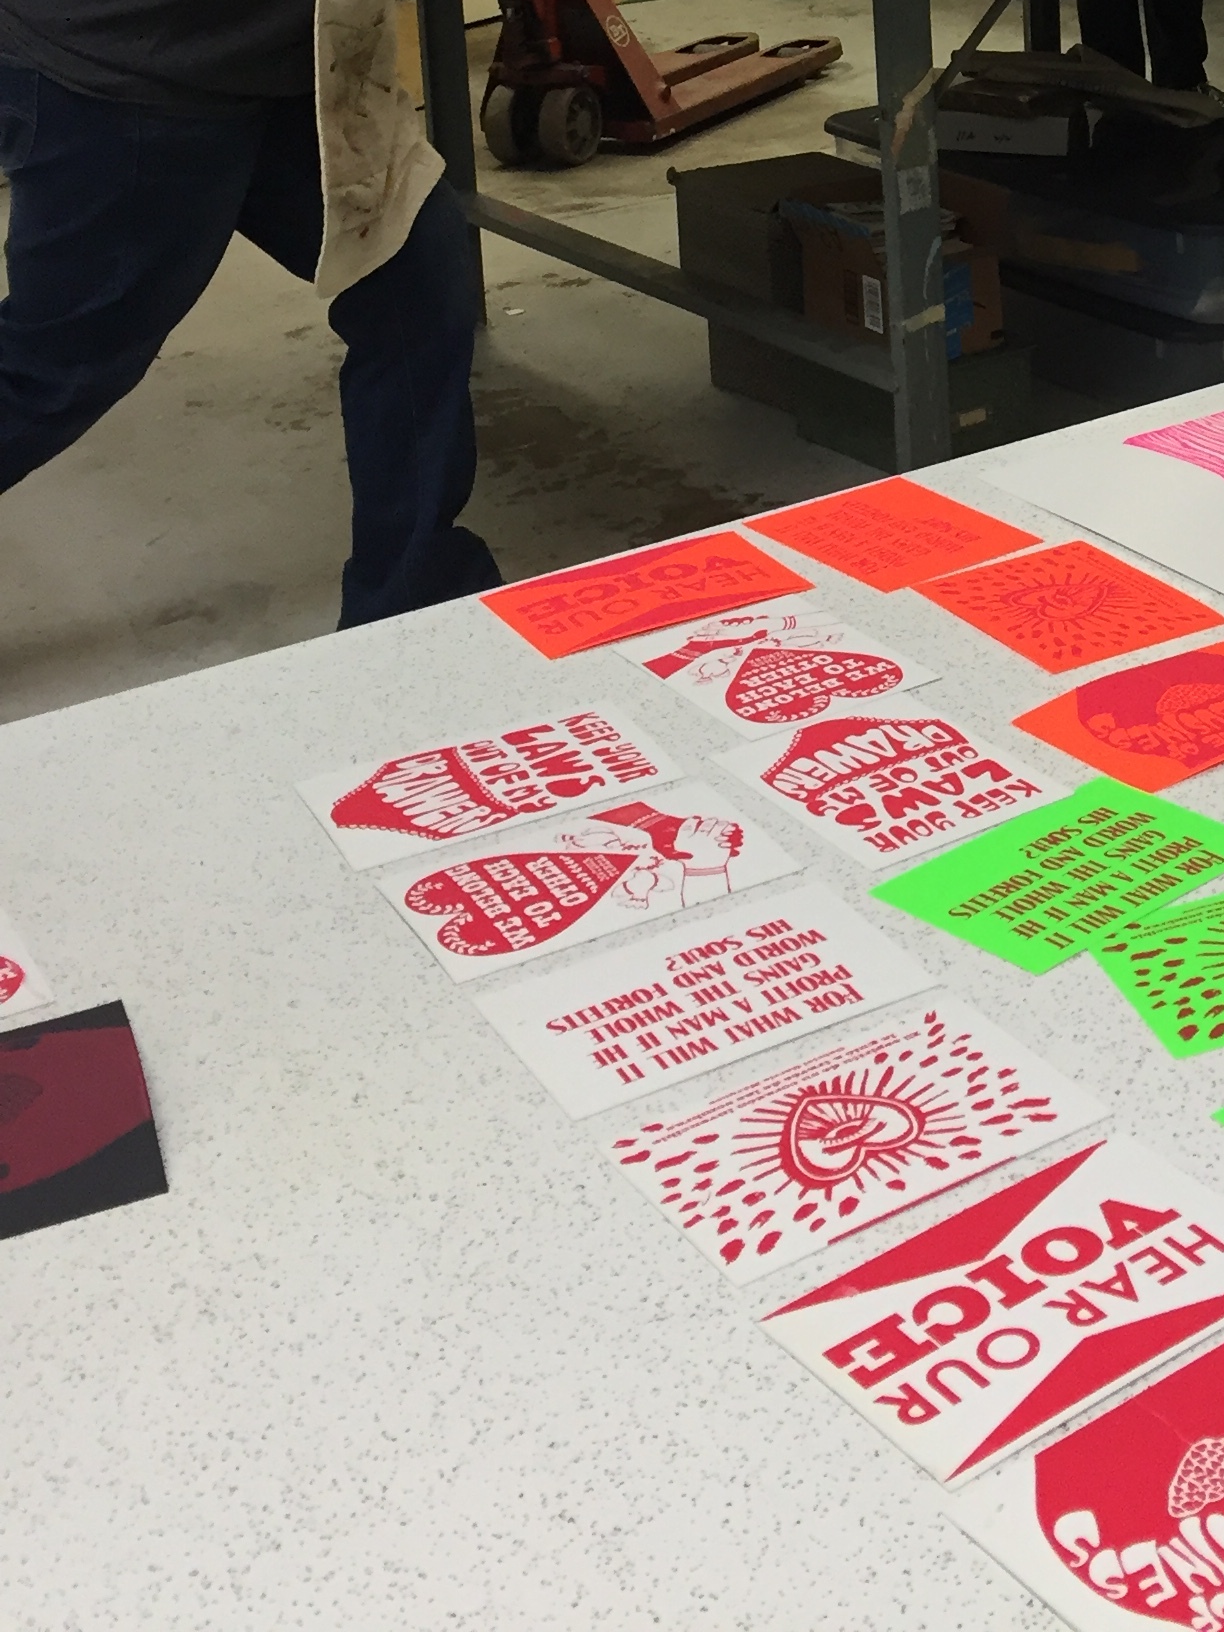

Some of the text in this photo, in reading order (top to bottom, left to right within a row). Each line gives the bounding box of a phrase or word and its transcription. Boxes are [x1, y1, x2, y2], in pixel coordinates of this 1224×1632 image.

[516, 555, 753, 623] VOICE
[537, 564, 772, 636] HEAR OUR
[735, 672, 818, 705] EACH
[735, 661, 896, 718] WE BELONG
[740, 654, 834, 687] OTHER
[822, 658, 865, 676] TO
[461, 740, 558, 814] OUT OF MY
[500, 724, 606, 798] LAWS
[558, 711, 659, 783] KEEP YOUR
[772, 724, 954, 801] DRAWERS
[805, 745, 980, 818] OUT OF MY
[1166, 741, 1200, 760] OF
[372, 752, 508, 835] DRAWERS
[834, 759, 1013, 833] LAWS
[863, 778, 1043, 853] KEEP YOUR
[948, 811, 1157, 920] WORLD AND FORFEITS
[1018, 807, 1119, 860] HIS SOUL?
[444, 863, 536, 950] WE BELONG
[483, 859, 562, 929] TO EACH
[525, 856, 589, 907] OTHER
[989, 830, 1166, 923] GAINS THE WHOLE
[1008, 836, 1204, 940] PROFIT A MAN IF HE
[1120, 873, 1183, 908] WHAT
[665, 918, 795, 972] HIS SOUL?
[1043, 931, 1075, 950] IT
[1066, 903, 1126, 934] WILL
[545, 929, 828, 1036] WORLD AND FORFEITS
[587, 952, 822, 1046] GAINS THE WHOLE
[590, 964, 854, 1069] PROFIT A MAN IF HE
[614, 983, 865, 1086] FOR WHAT WILL IT
[822, 1199, 1182, 1390] VOICE
[874, 1327, 1041, 1427] OUR
